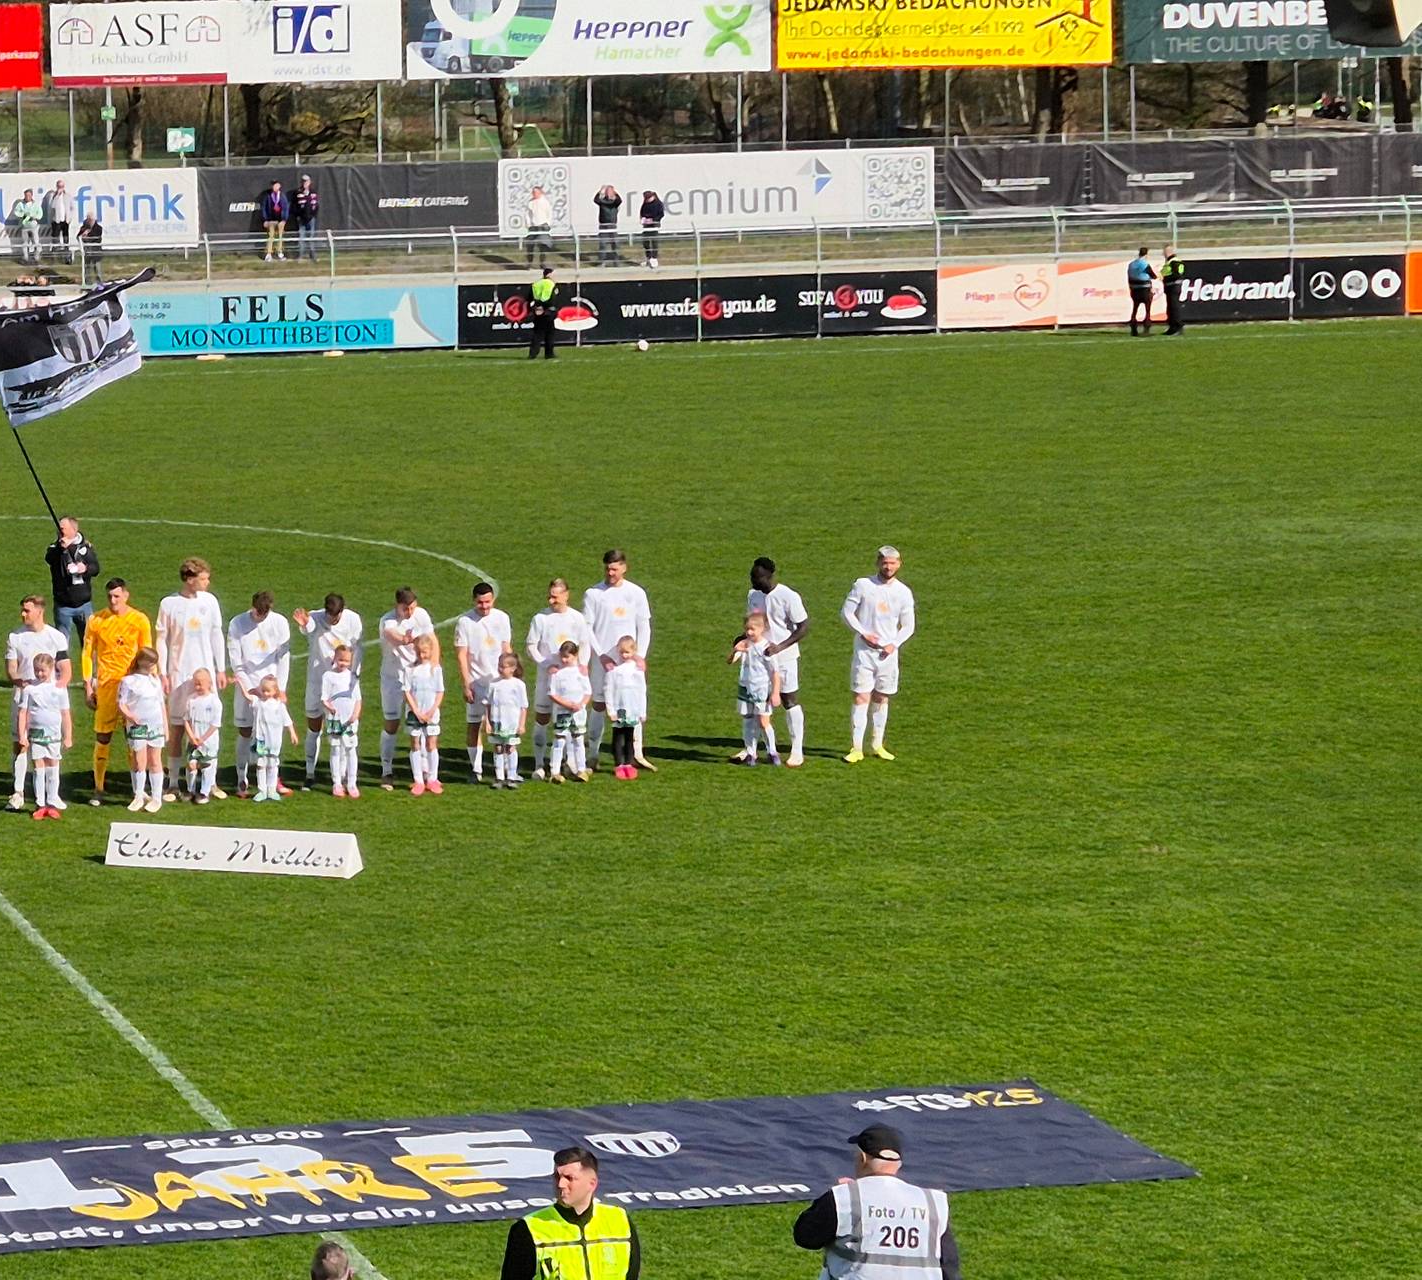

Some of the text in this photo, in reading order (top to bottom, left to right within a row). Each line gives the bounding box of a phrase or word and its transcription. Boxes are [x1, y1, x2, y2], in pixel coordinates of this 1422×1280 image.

[1163, 0, 1328, 29] DUVENBE
[101, 13, 178, 47] ASF
[994, 21, 1024, 33] 1992
[595, 45, 681, 61] Hamacher
[786, 46, 1025, 61] www.jedamski-bedachungen.de
[1166, 37, 1202, 53] THE
[1206, 34, 1290, 53] CULTURE
[1296, 33, 1322, 50] OF
[91, 52, 144, 65] Hochbau
[219, 294, 324, 324] FELS
[171, 323, 378, 349] MONOLITHBETON
[114, 832, 344, 867] Elektro Mölders
[143, 1130, 325, 1150] SEIT 1900
[70, 1153, 508, 1221] JAHRE
[135, 1215, 264, 1234] unser
[270, 1206, 436, 1226] Verein,
[445, 1196, 601, 1214] unse
[606, 1183, 812, 1203] Tradition
[868, 1206, 895, 1219] Foto
[912, 1207, 926, 1219] TV
[879, 1226, 920, 1248] 206
